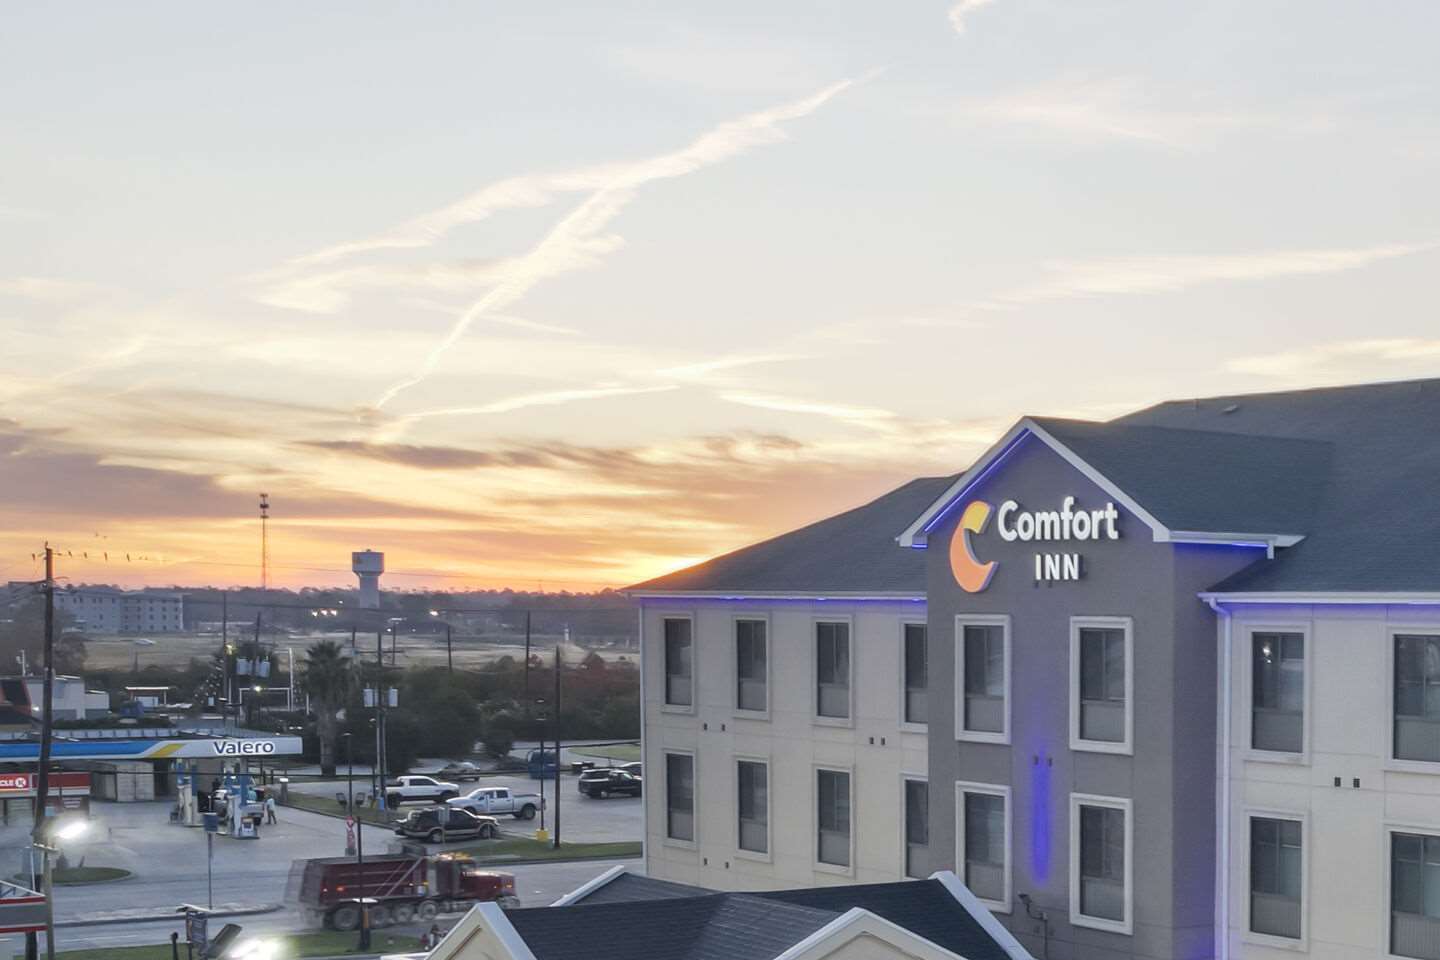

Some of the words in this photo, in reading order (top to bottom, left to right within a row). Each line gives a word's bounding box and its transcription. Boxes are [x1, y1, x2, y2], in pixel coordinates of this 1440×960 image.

[998, 496, 1119, 541] Comfort
[1035, 554, 1079, 580] INN
[213, 740, 274, 754] Valero
